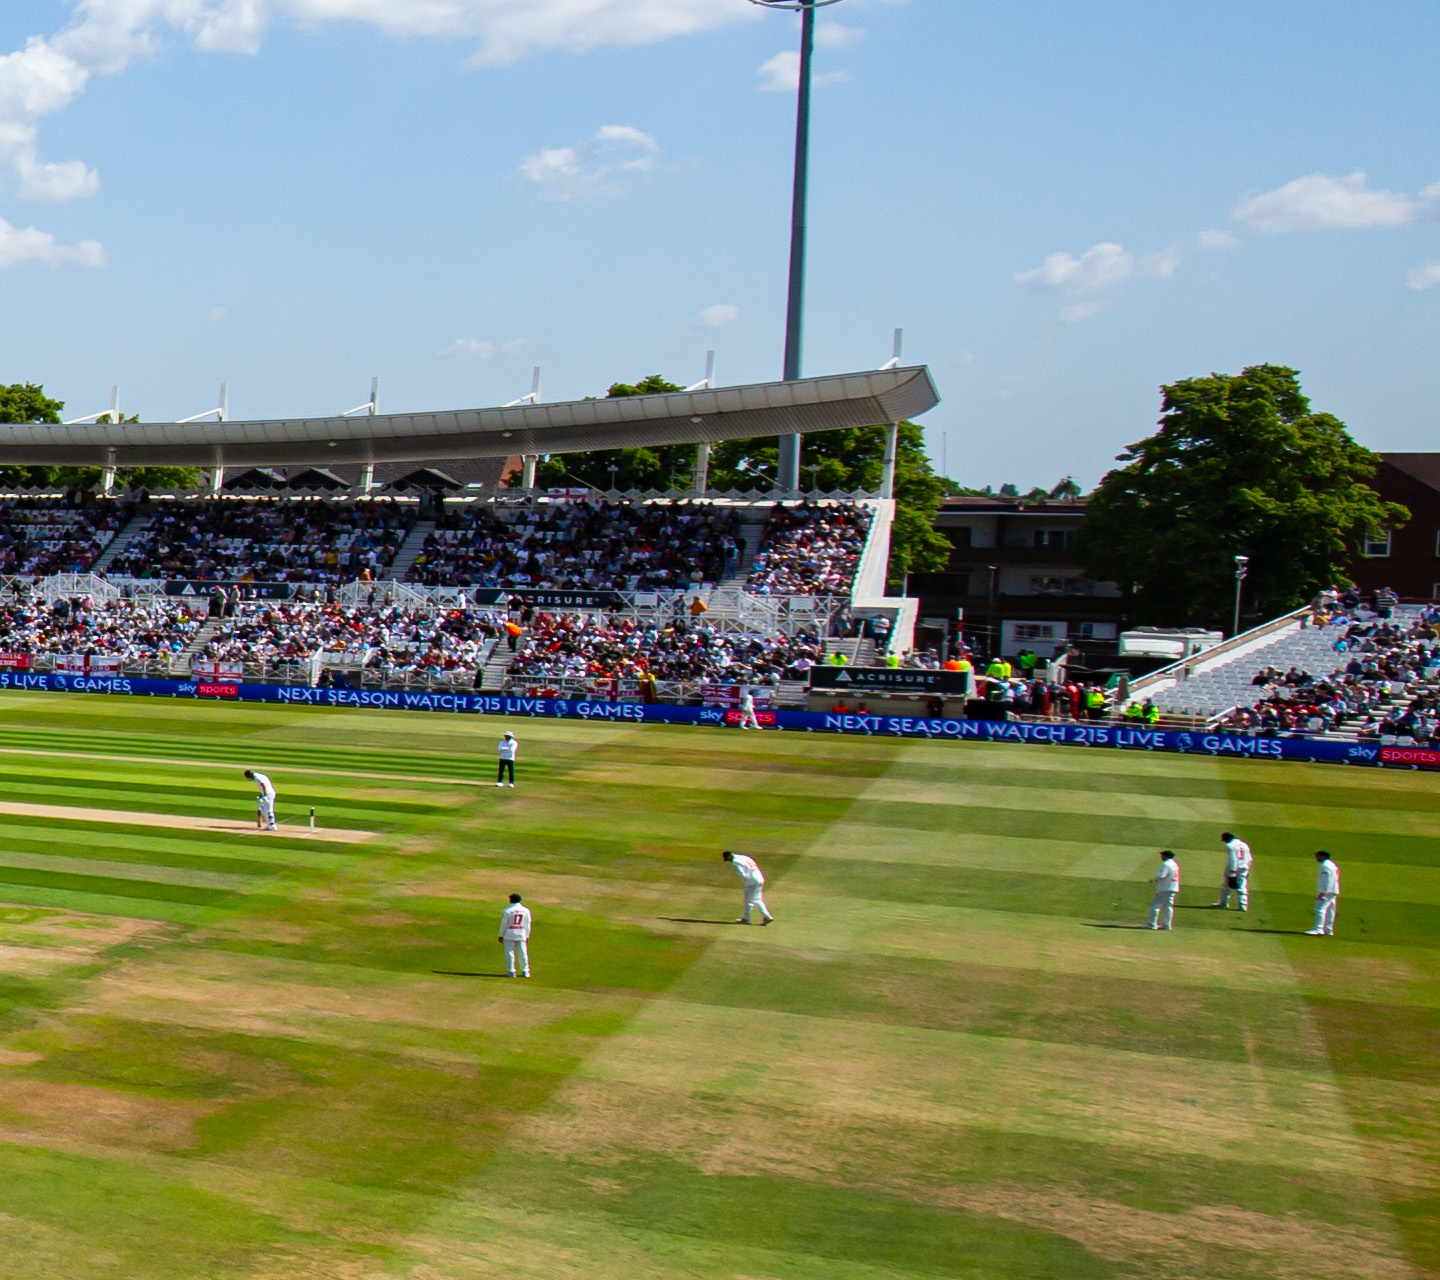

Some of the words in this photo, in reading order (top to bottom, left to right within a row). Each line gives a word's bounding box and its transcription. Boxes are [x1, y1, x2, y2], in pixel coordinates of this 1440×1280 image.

[14, 674, 47, 687] LIVE
[73, 678, 131, 691] GAMES
[857, 673, 935, 683] ACRISURE
[177, 683, 197, 693] sky
[199, 685, 236, 695] sports
[278, 687, 323, 700] NEXT
[328, 690, 399, 705] SEASON
[404, 693, 467, 708] WATCH
[473, 698, 500, 710] 215
[506, 699, 545, 713] LIVE
[576, 703, 644, 718] GAMES
[700, 710, 723, 721] sky
[826, 715, 882, 729] NEXT
[889, 718, 979, 735] SEASON
[987, 721, 1066, 740] WATCH
[1074, 727, 1108, 742] 215
[1116, 730, 1165, 747] LIVE
[1203, 735, 1283, 754] GAMES
[1349, 746, 1377, 759] sky
[1382, 749, 1437, 762] sports
